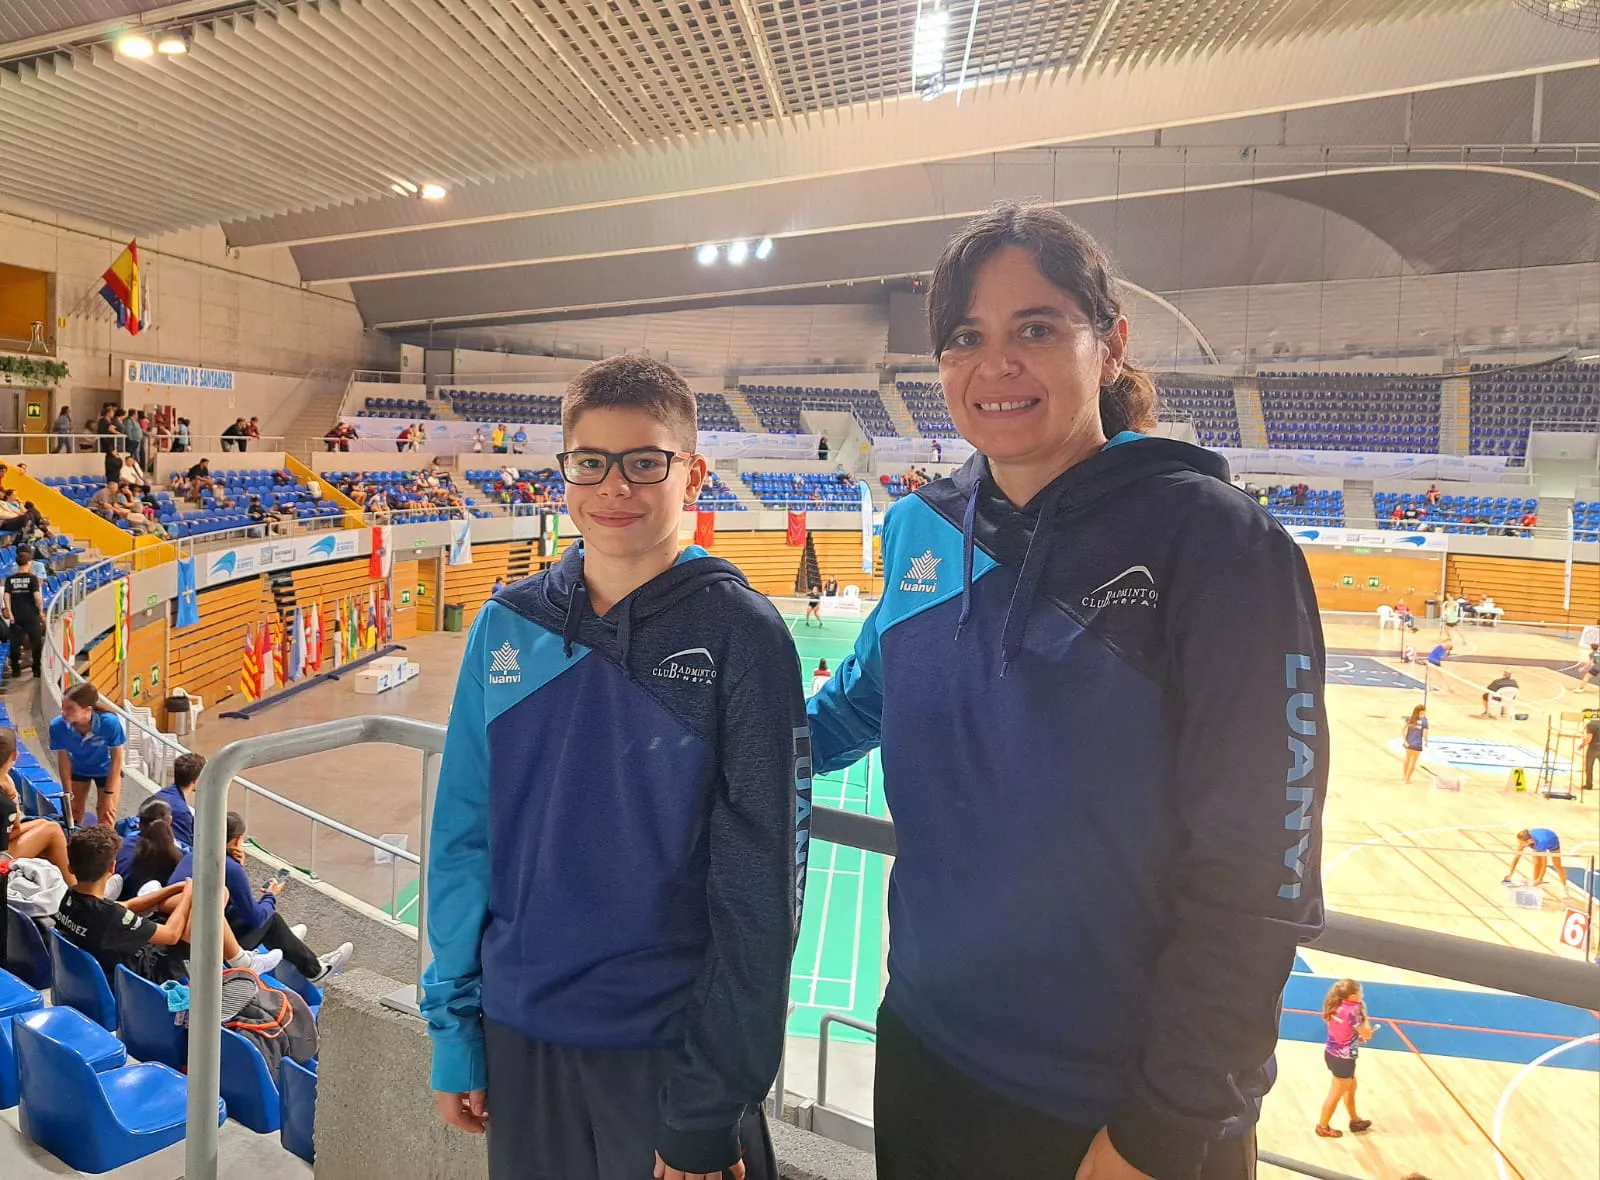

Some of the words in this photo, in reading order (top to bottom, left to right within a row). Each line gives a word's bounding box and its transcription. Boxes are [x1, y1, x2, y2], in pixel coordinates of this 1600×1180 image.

[139, 363, 189, 386] AYUNTAMIENTO
[190, 368, 199, 387] DE
[200, 369, 233, 389] SANTANDER
[900, 580, 936, 593] luanvi
[489, 672, 521, 684] luanvi
[1277, 653, 1317, 899] LUANVI
[1513, 769, 1523, 787] 2
[1564, 912, 1586, 947] 6
